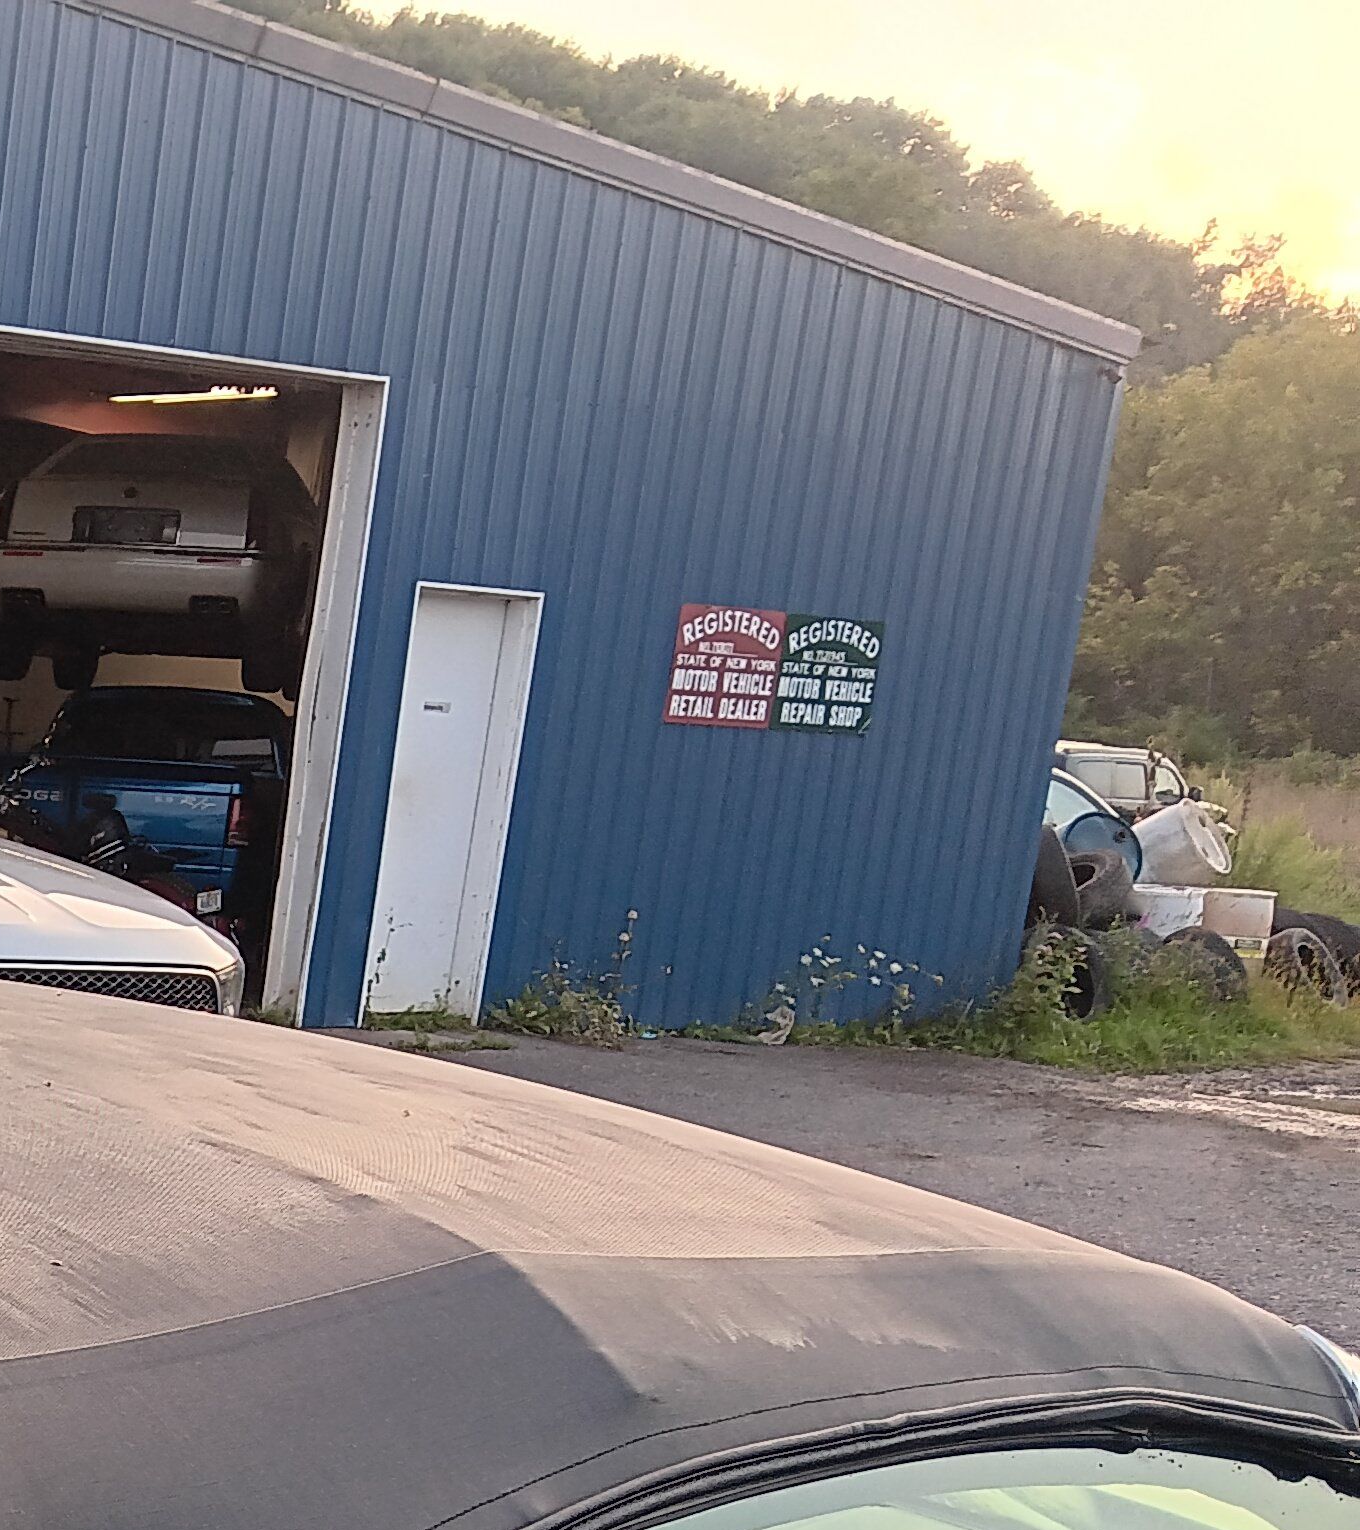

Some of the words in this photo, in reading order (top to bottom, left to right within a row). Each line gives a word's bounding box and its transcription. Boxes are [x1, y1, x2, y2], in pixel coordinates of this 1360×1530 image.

[682, 609, 780, 650] REGISTERED
[788, 619, 880, 659] REGISTERED
[676, 653, 708, 668] STATE
[709, 655, 725, 668] OF
[725, 657, 748, 670] NEW
[750, 659, 777, 672] YORK
[782, 661, 812, 676] STATE
[812, 664, 827, 676] OF
[827, 665, 849, 678] NEW
[851, 667, 877, 680] YORK
[671, 668, 718, 692] MOTOR
[722, 671, 775, 697] VEHICLE
[777, 676, 821, 700] MOTOR
[824, 679, 874, 704] VEHICLE
[669, 694, 714, 719] RETAIL
[717, 697, 768, 722] DEALER
[780, 701, 826, 726] REPAIR
[829, 704, 863, 728] SHOP
